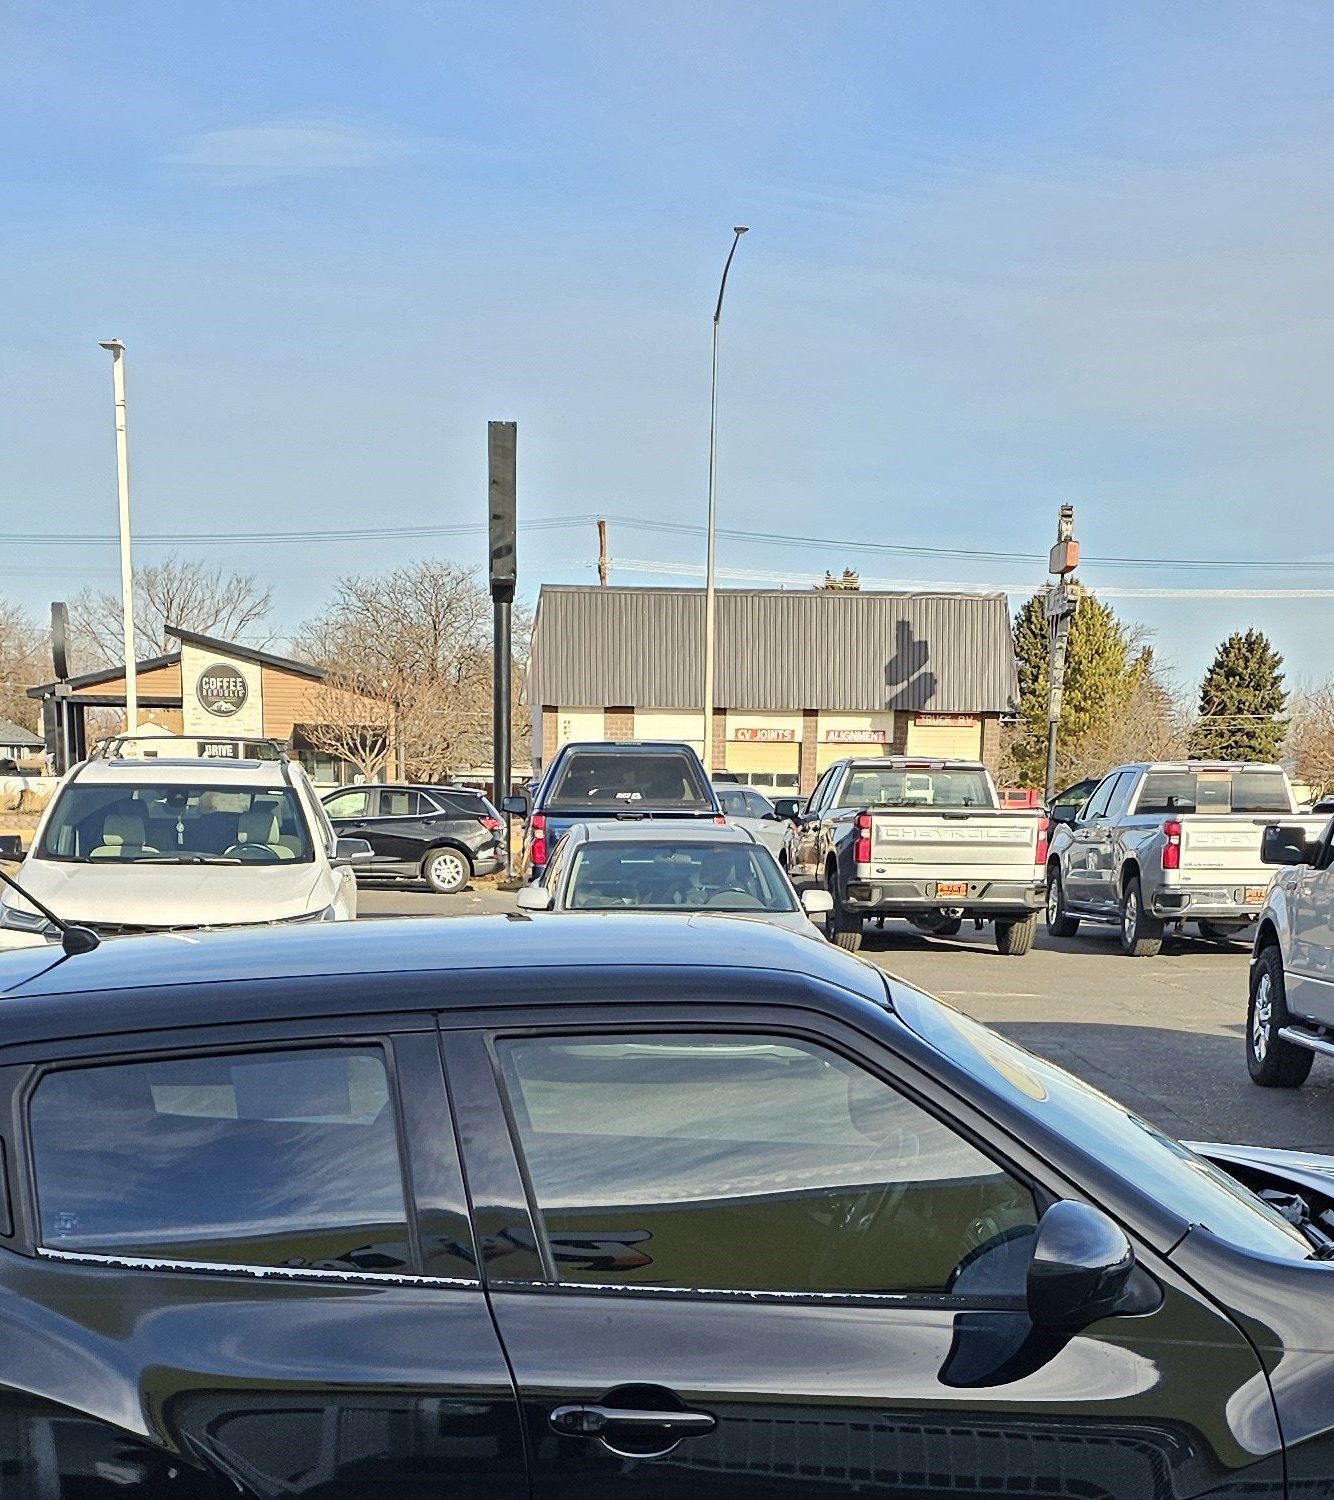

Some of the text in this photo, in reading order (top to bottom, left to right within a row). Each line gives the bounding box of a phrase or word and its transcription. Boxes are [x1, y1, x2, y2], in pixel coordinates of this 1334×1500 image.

[202, 676, 244, 690] COFFEE
[754, 728, 792, 741] JOINTS
[827, 730, 885, 742] ALIGNMENT
[204, 744, 234, 757] DRIVE
[884, 828, 1027, 838] CHEVROLET
